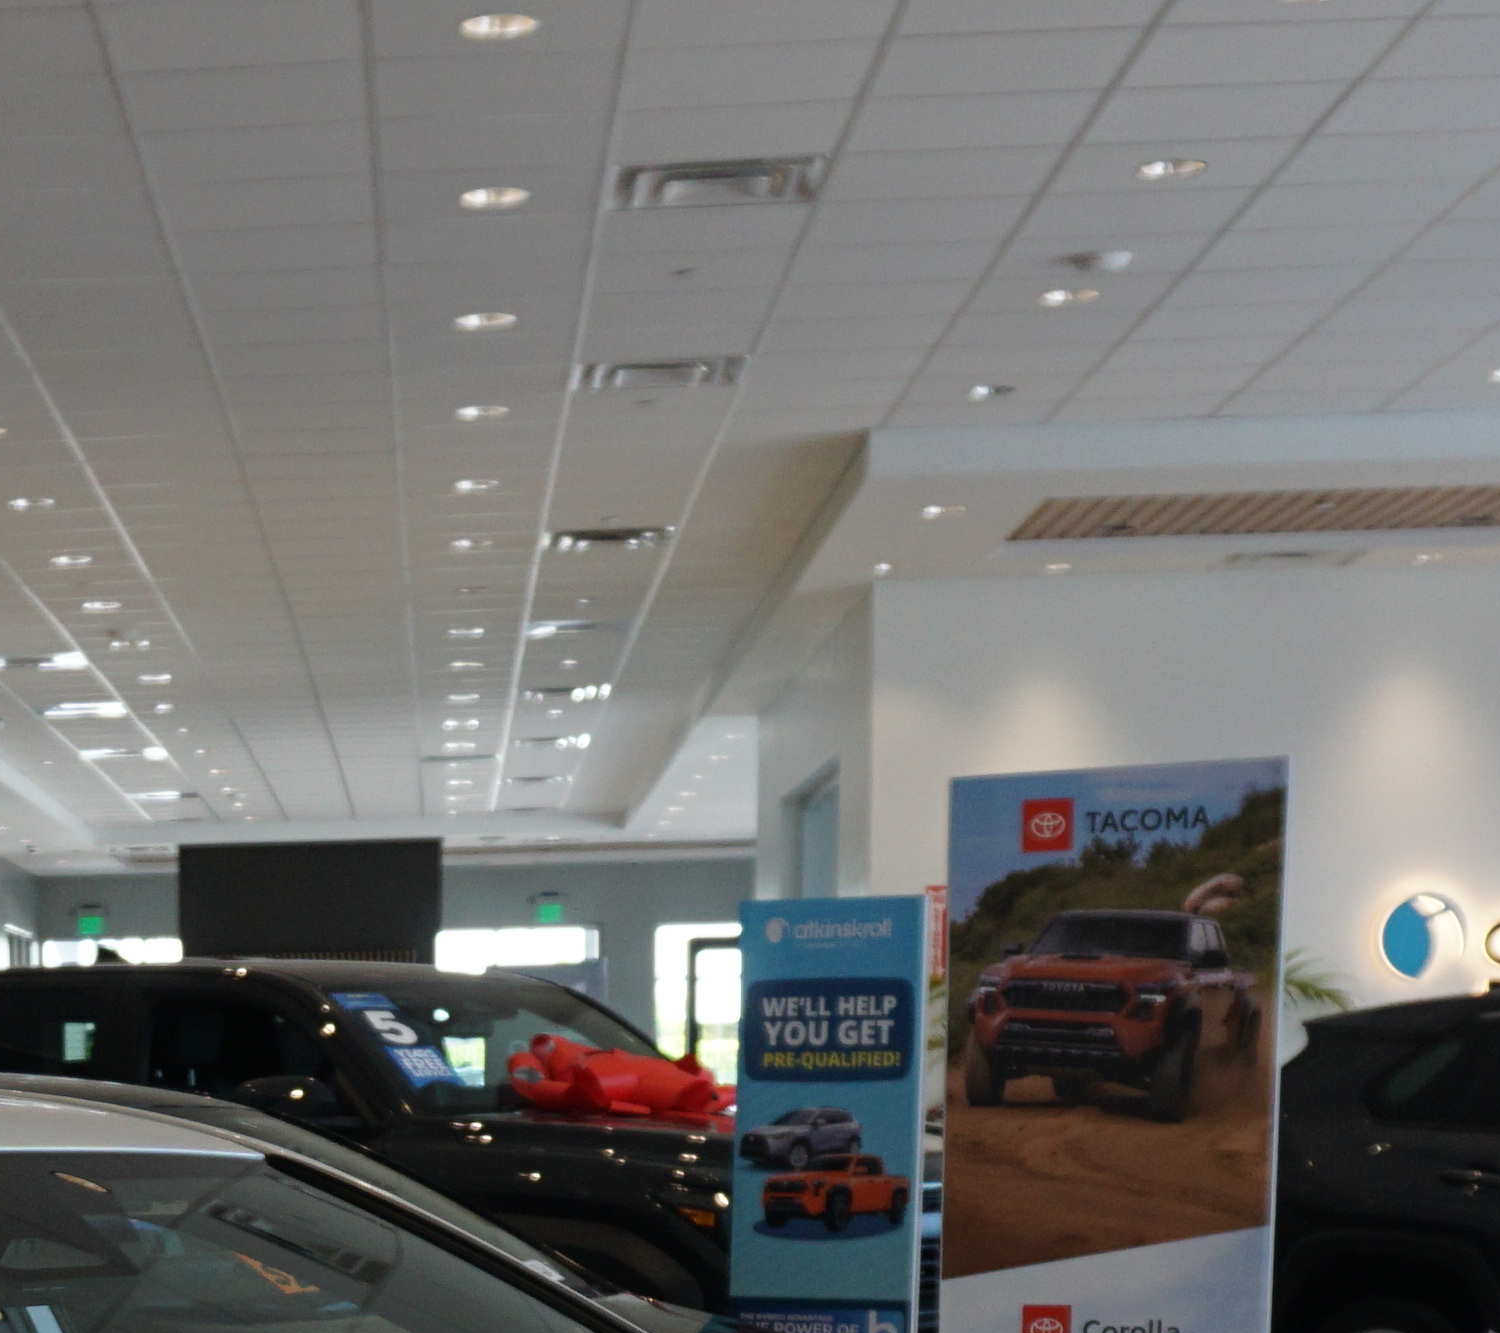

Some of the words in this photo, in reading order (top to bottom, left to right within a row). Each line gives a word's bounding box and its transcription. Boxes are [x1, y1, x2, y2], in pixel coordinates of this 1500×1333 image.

[1086, 805, 1210, 833] TACOMA
[762, 996, 831, 1017] WE'LL
[837, 995, 897, 1016] HELP
[363, 1010, 418, 1044] 5
[764, 1020, 829, 1046] YOU
[838, 1019, 895, 1046] GET
[762, 1051, 902, 1070] PRE-QUALIFIED!
